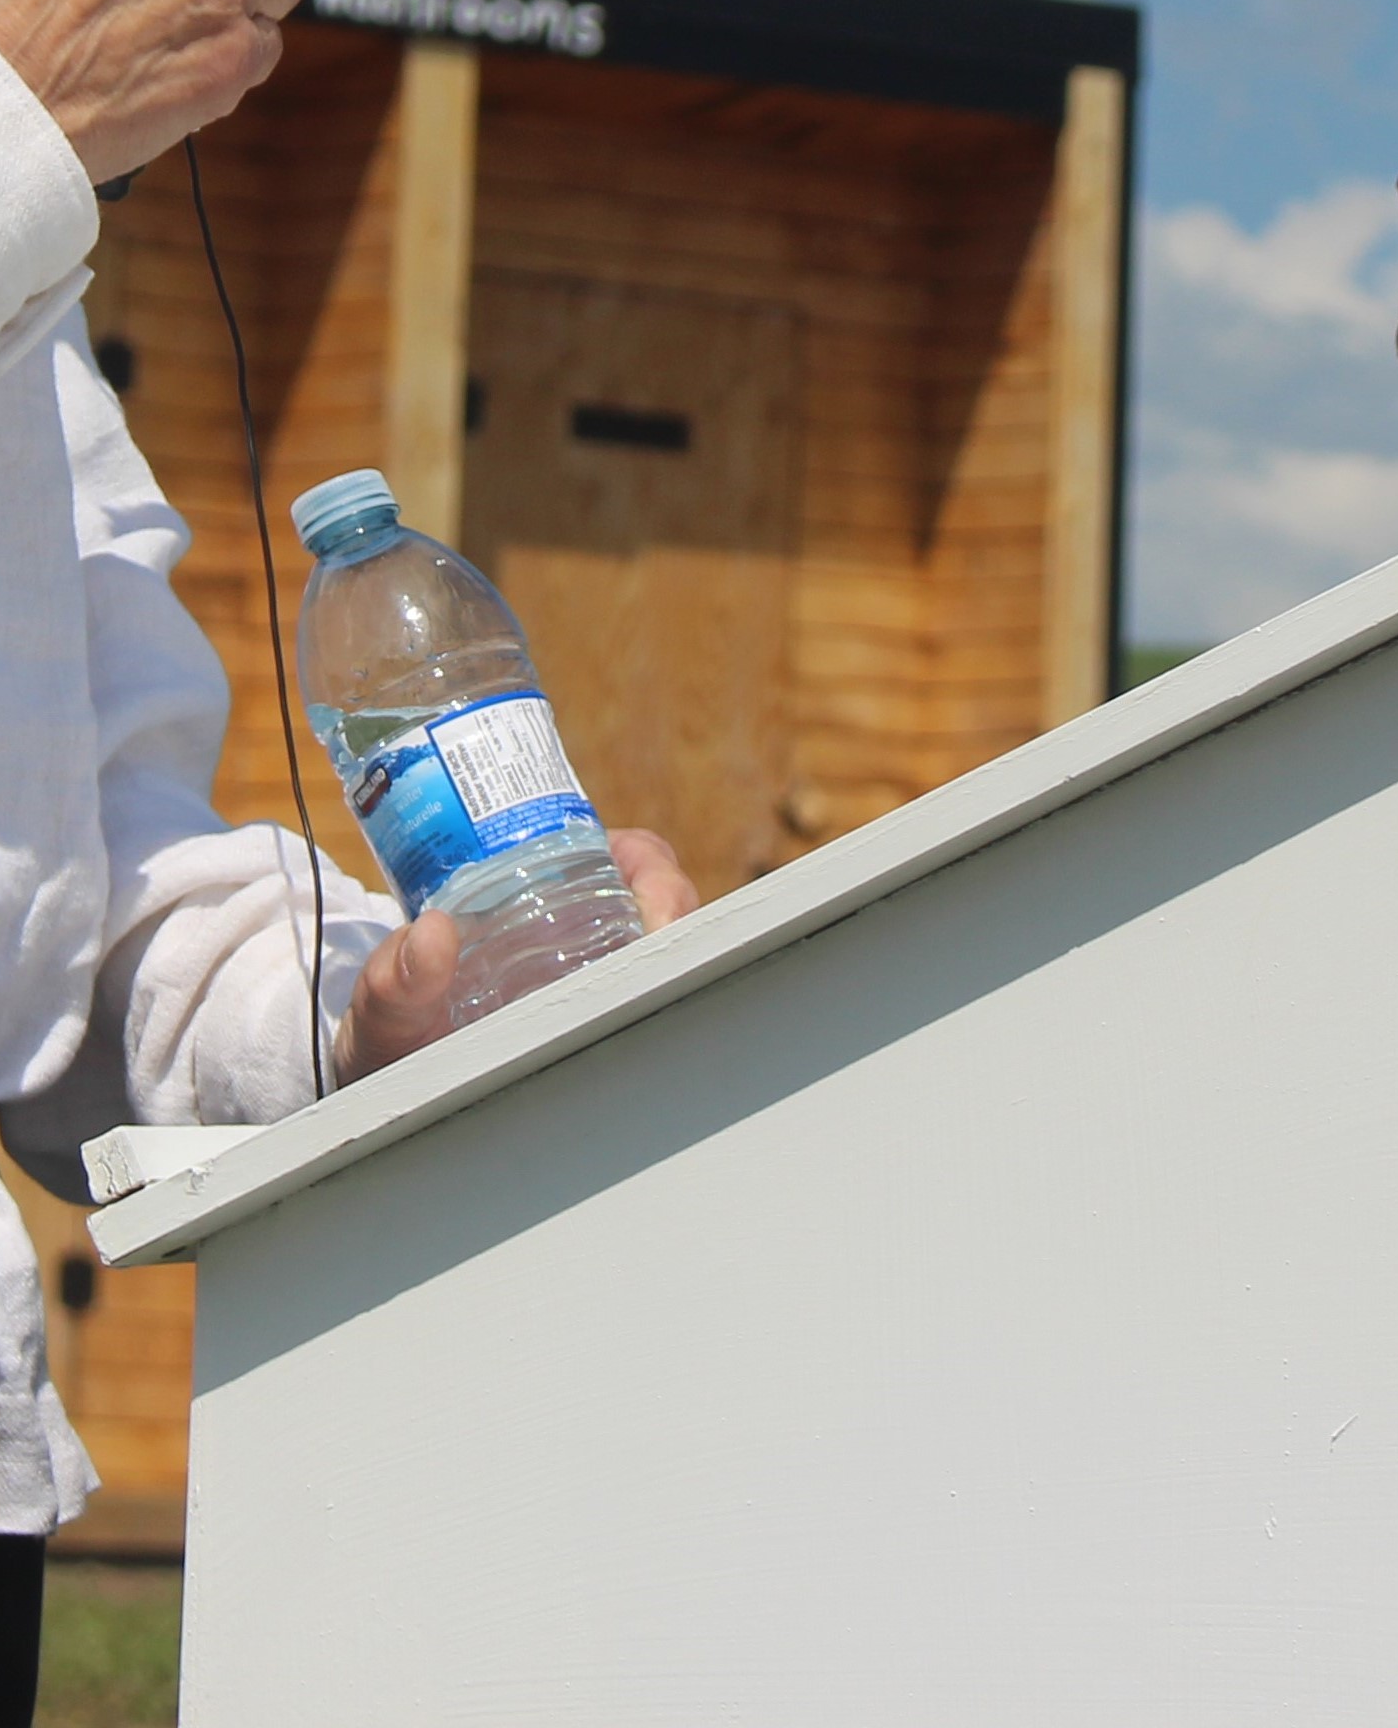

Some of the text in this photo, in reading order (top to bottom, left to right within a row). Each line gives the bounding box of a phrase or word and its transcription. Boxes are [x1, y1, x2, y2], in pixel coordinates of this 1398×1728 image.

[446, 749, 482, 818] Nutrition Facts
[474, 782, 493, 815] Valeur
[399, 800, 443, 836] aturelle
